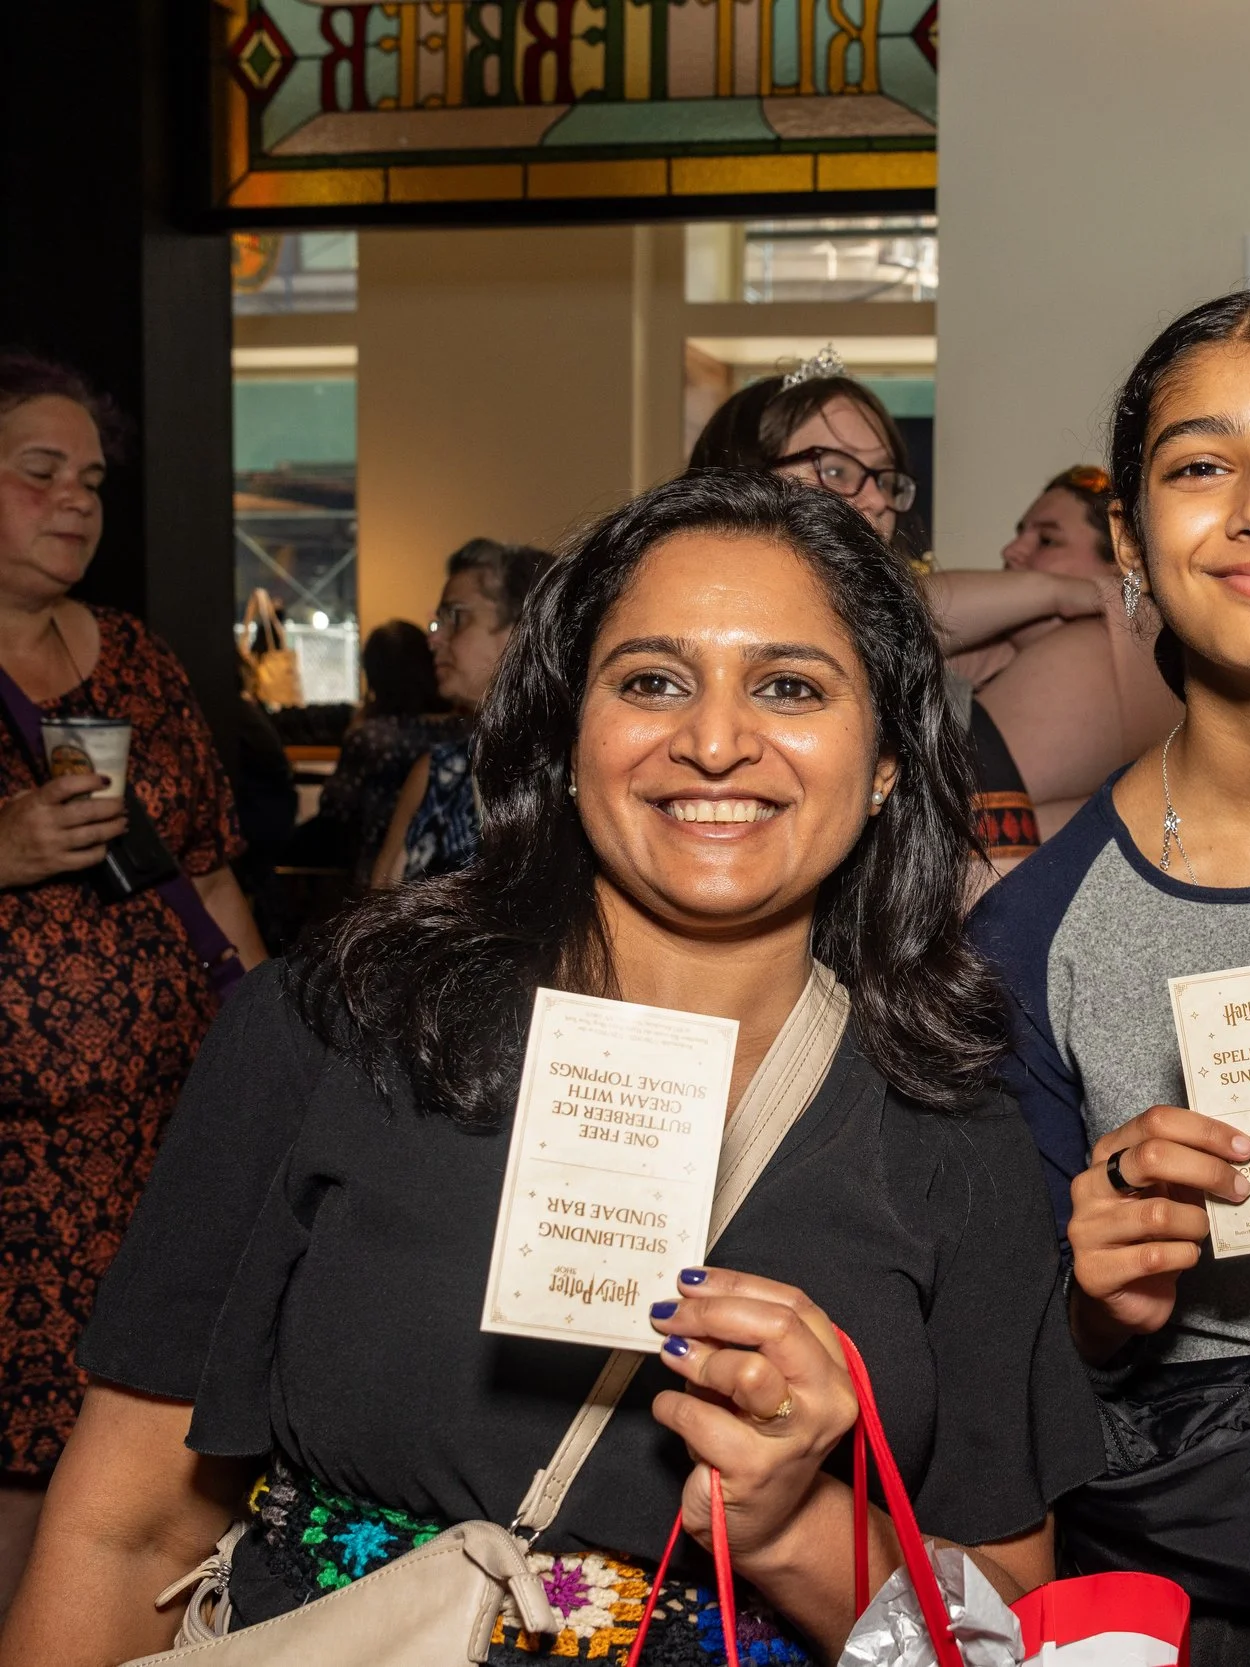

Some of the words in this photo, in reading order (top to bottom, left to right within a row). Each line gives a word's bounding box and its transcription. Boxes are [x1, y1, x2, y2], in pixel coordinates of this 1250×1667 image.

[550, 1062, 632, 1087] TOPPINGS
[568, 1084, 613, 1103] WITH
[638, 1077, 707, 1099] SUNDAE
[552, 1101, 578, 1117] ICE
[621, 1093, 682, 1113] CREAM
[584, 1106, 692, 1134] BUTTERBEER
[579, 1124, 619, 1142] FREE
[624, 1132, 658, 1148] ONE
[548, 1197, 585, 1216] BAR
[590, 1204, 667, 1228] SUNDAE
[539, 1222, 667, 1254] SPELLBINDING
[553, 1266, 576, 1276] SHOP
[549, 1273, 596, 1304] Potter
[595, 1279, 639, 1306] Harry
